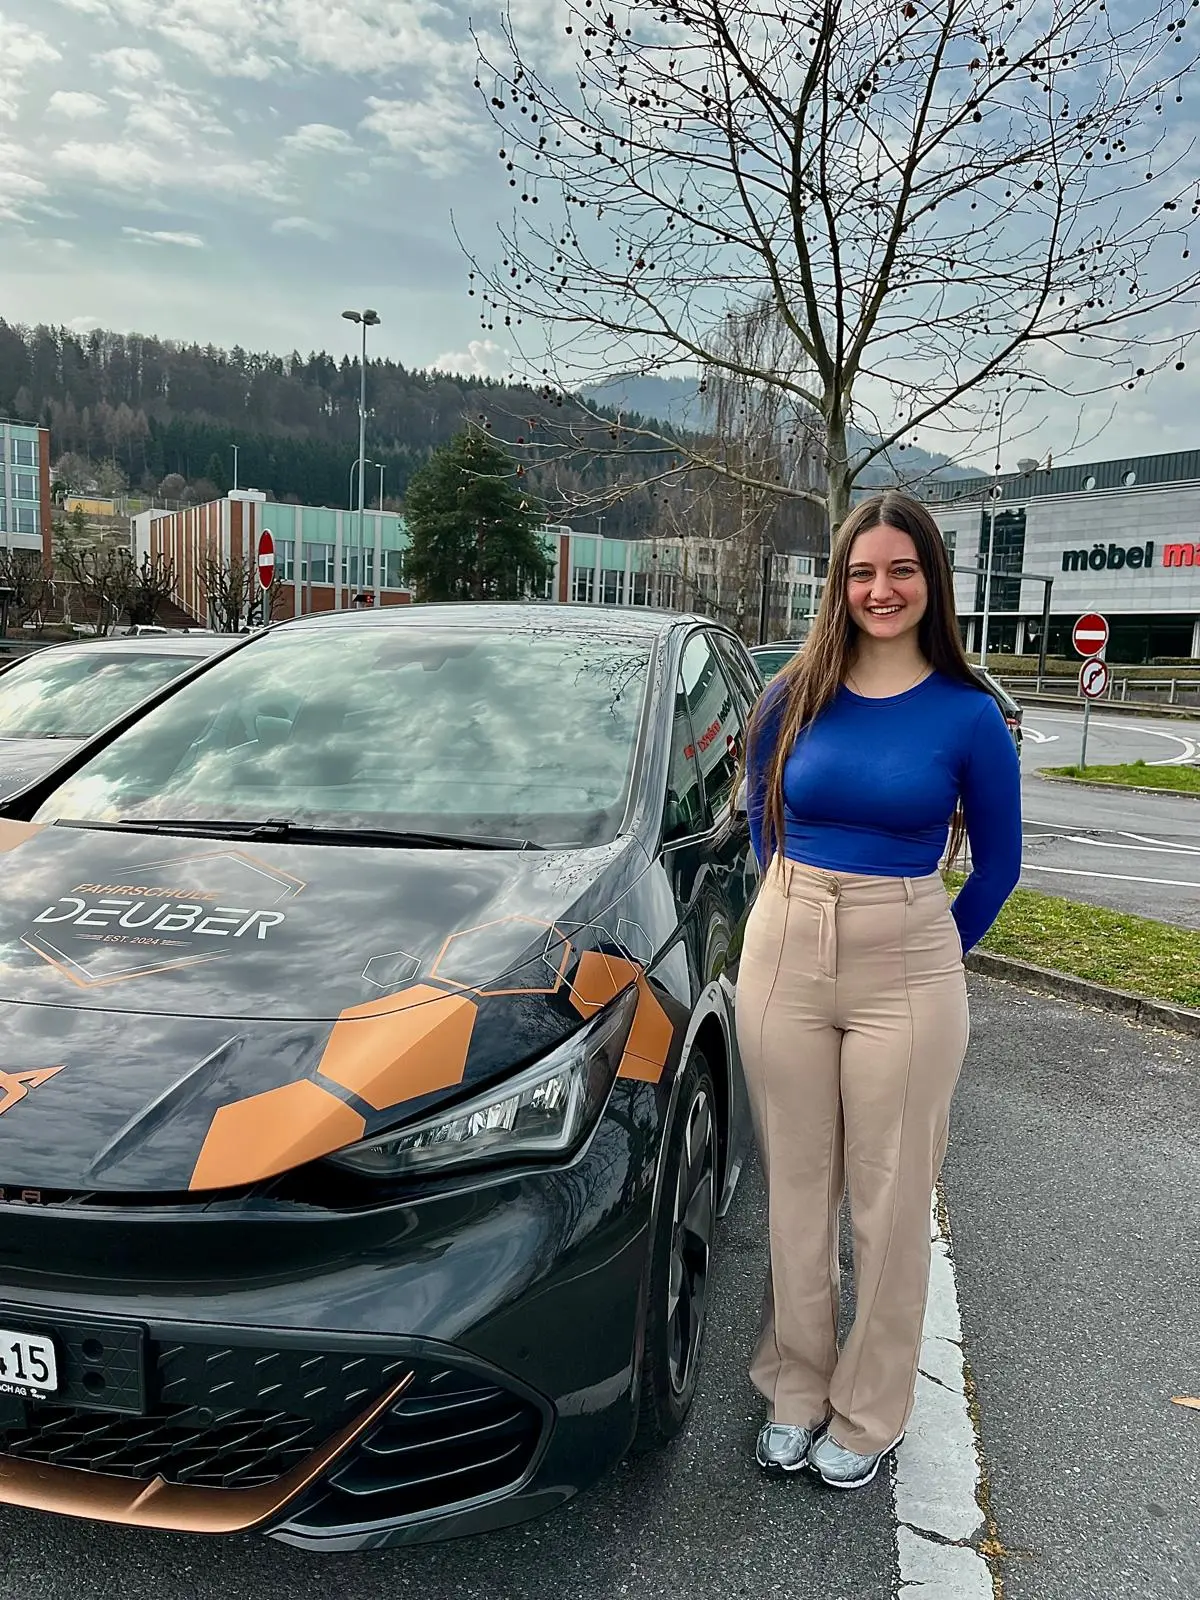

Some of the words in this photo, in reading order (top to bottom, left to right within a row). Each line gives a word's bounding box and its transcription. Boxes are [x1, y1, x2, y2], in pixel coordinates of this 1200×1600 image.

[1061, 541, 1154, 572] möbel
[70, 883, 220, 901] FAHRSCHULE
[32, 897, 286, 940] DEUBER
[103, 934, 127, 943] EST.
[130, 937, 161, 946] 2024
[15, 1386, 27, 1396] AG
